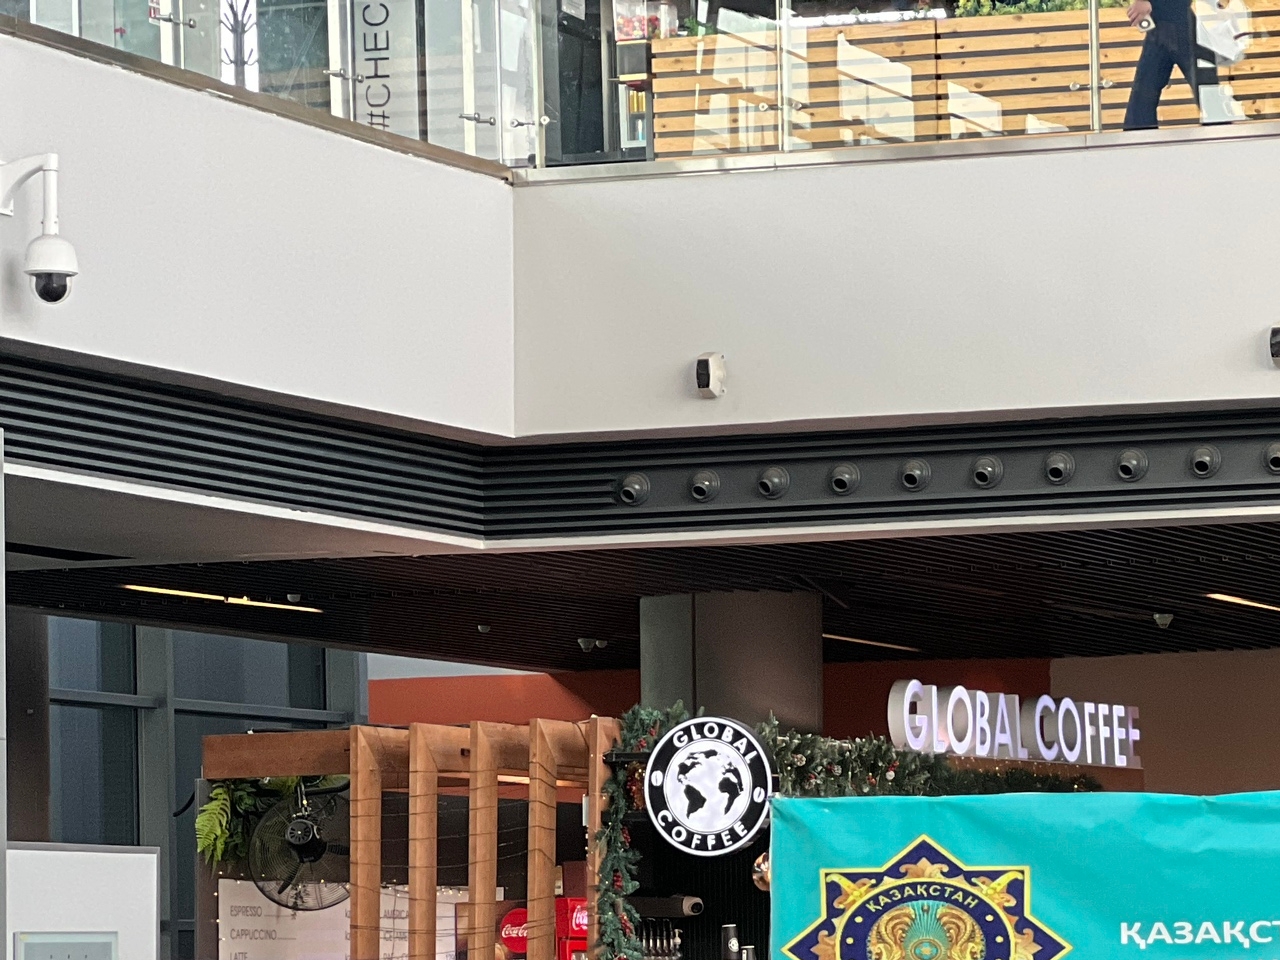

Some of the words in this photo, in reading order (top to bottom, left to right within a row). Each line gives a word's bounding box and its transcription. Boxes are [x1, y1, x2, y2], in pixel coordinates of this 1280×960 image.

[891, 679, 1028, 758] GLOBAL
[1034, 694, 1142, 769] COFFEE
[673, 722, 758, 764] GLOBAL
[657, 809, 748, 850] COFFEE
[230, 906, 262, 917] ESPRESSO
[865, 884, 979, 913] ҚАЗАҚСТАН
[230, 929, 277, 940] CAPPUCCINO
